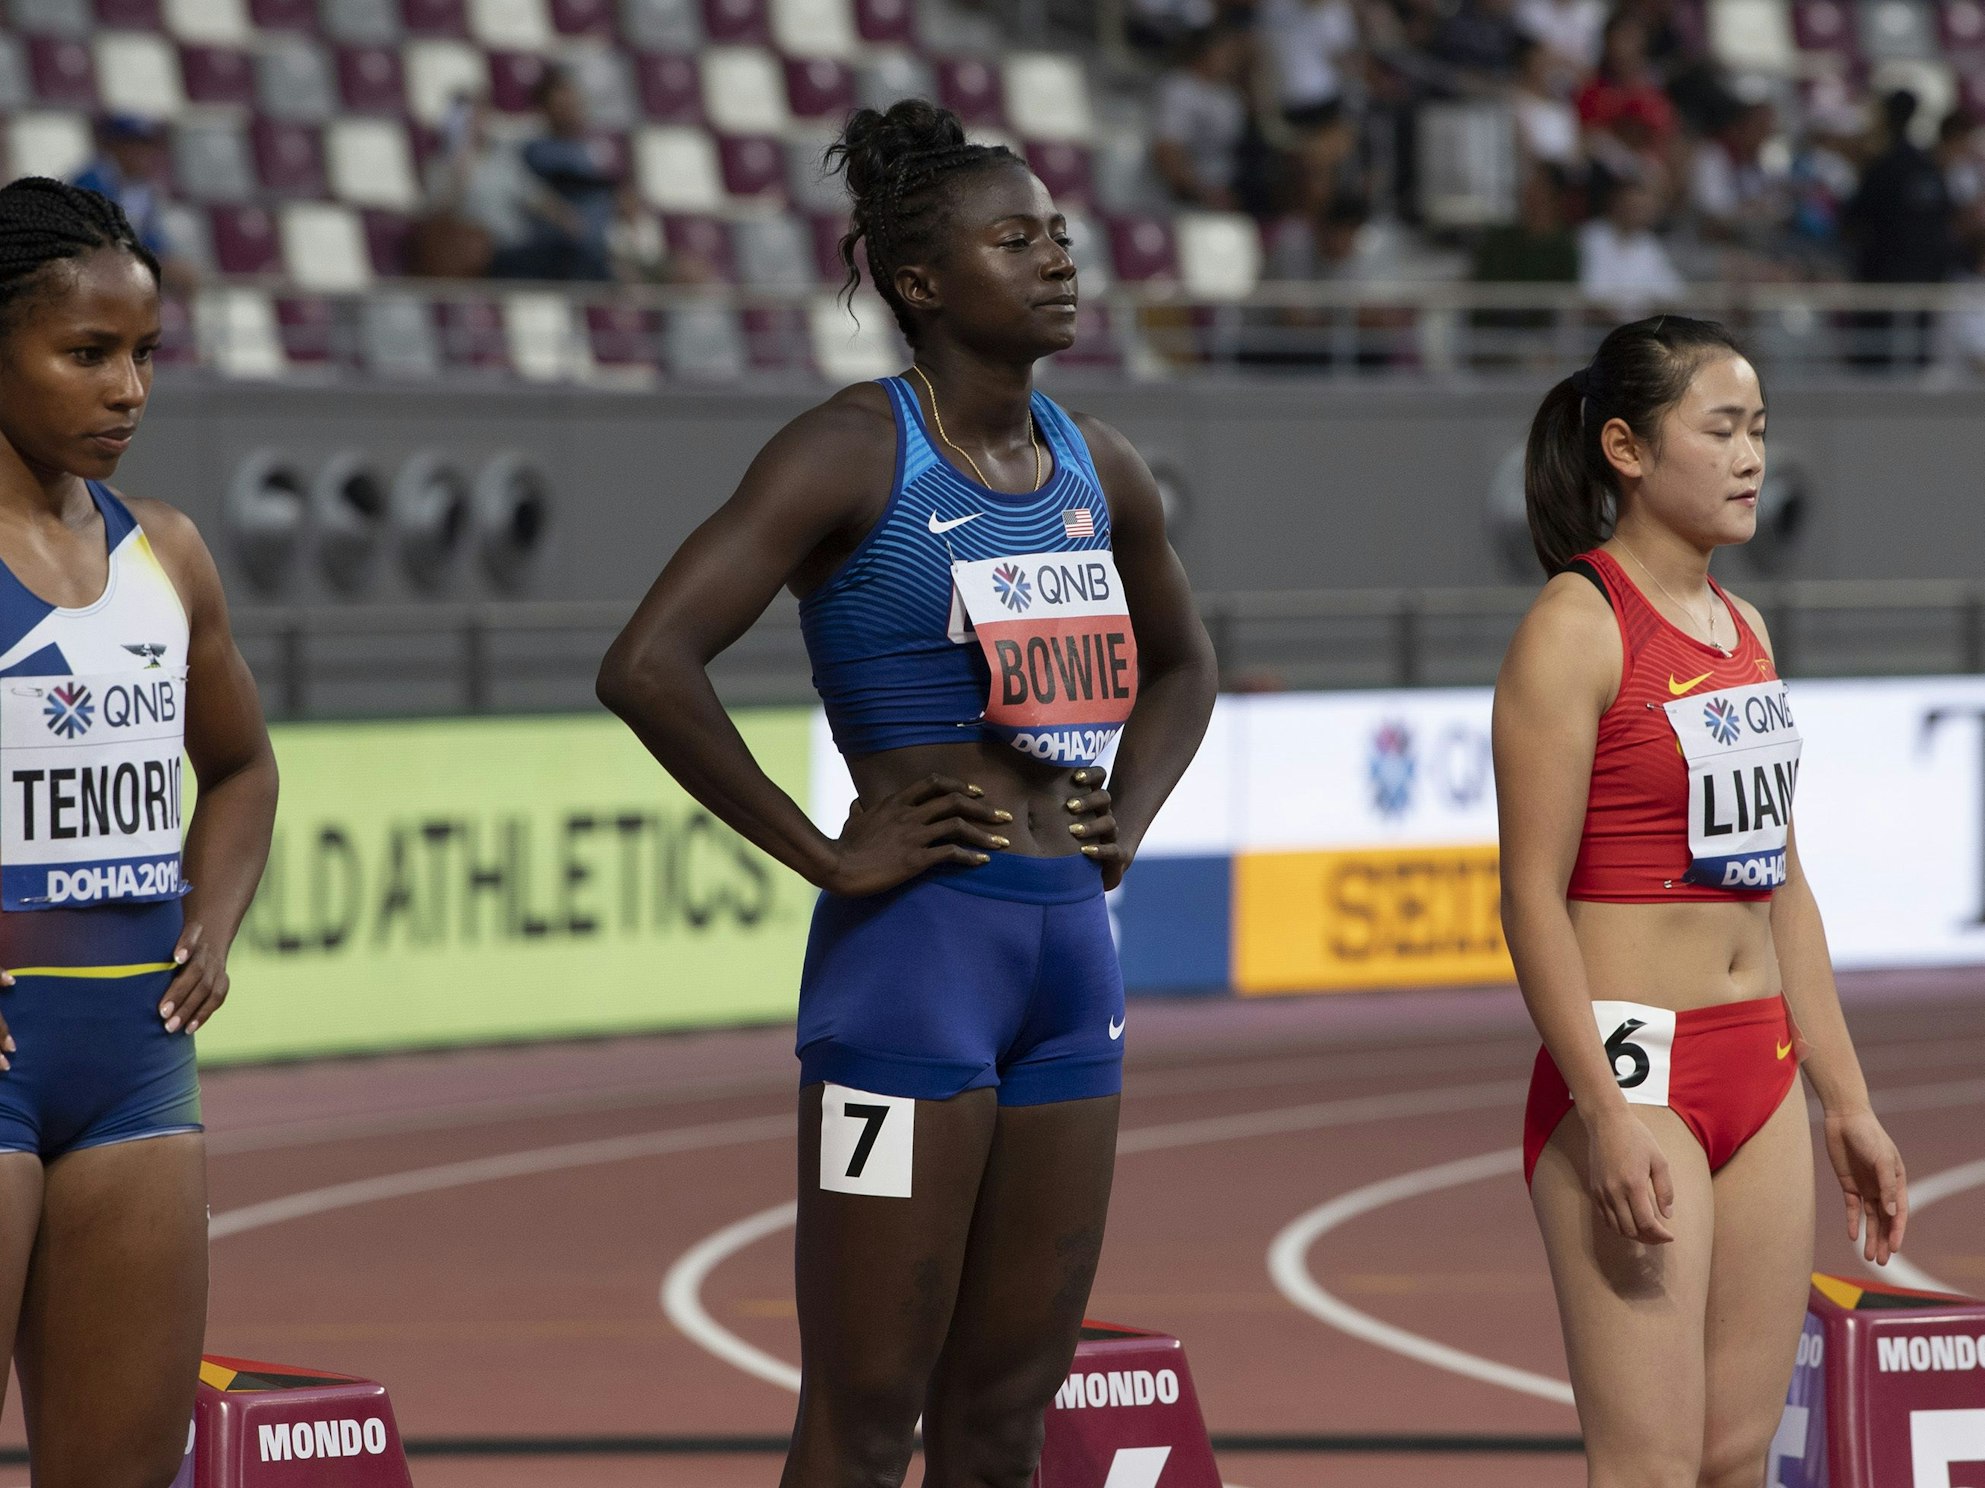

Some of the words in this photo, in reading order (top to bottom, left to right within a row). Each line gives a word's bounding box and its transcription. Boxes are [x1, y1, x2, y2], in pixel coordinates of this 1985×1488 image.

[1036, 562, 1110, 605] QNB
[995, 633, 1130, 706] BOWIE
[103, 681, 176, 728] QNB
[12, 756, 182, 841] TENORIO
[1703, 758, 1800, 837] LIAN
[1721, 851, 1786, 886] DOHA
[1604, 1018, 1650, 1088] 6
[844, 1102, 890, 1178] 7
[1055, 1369, 1180, 1410] MONDO
[258, 1417, 387, 1462] MONDO
